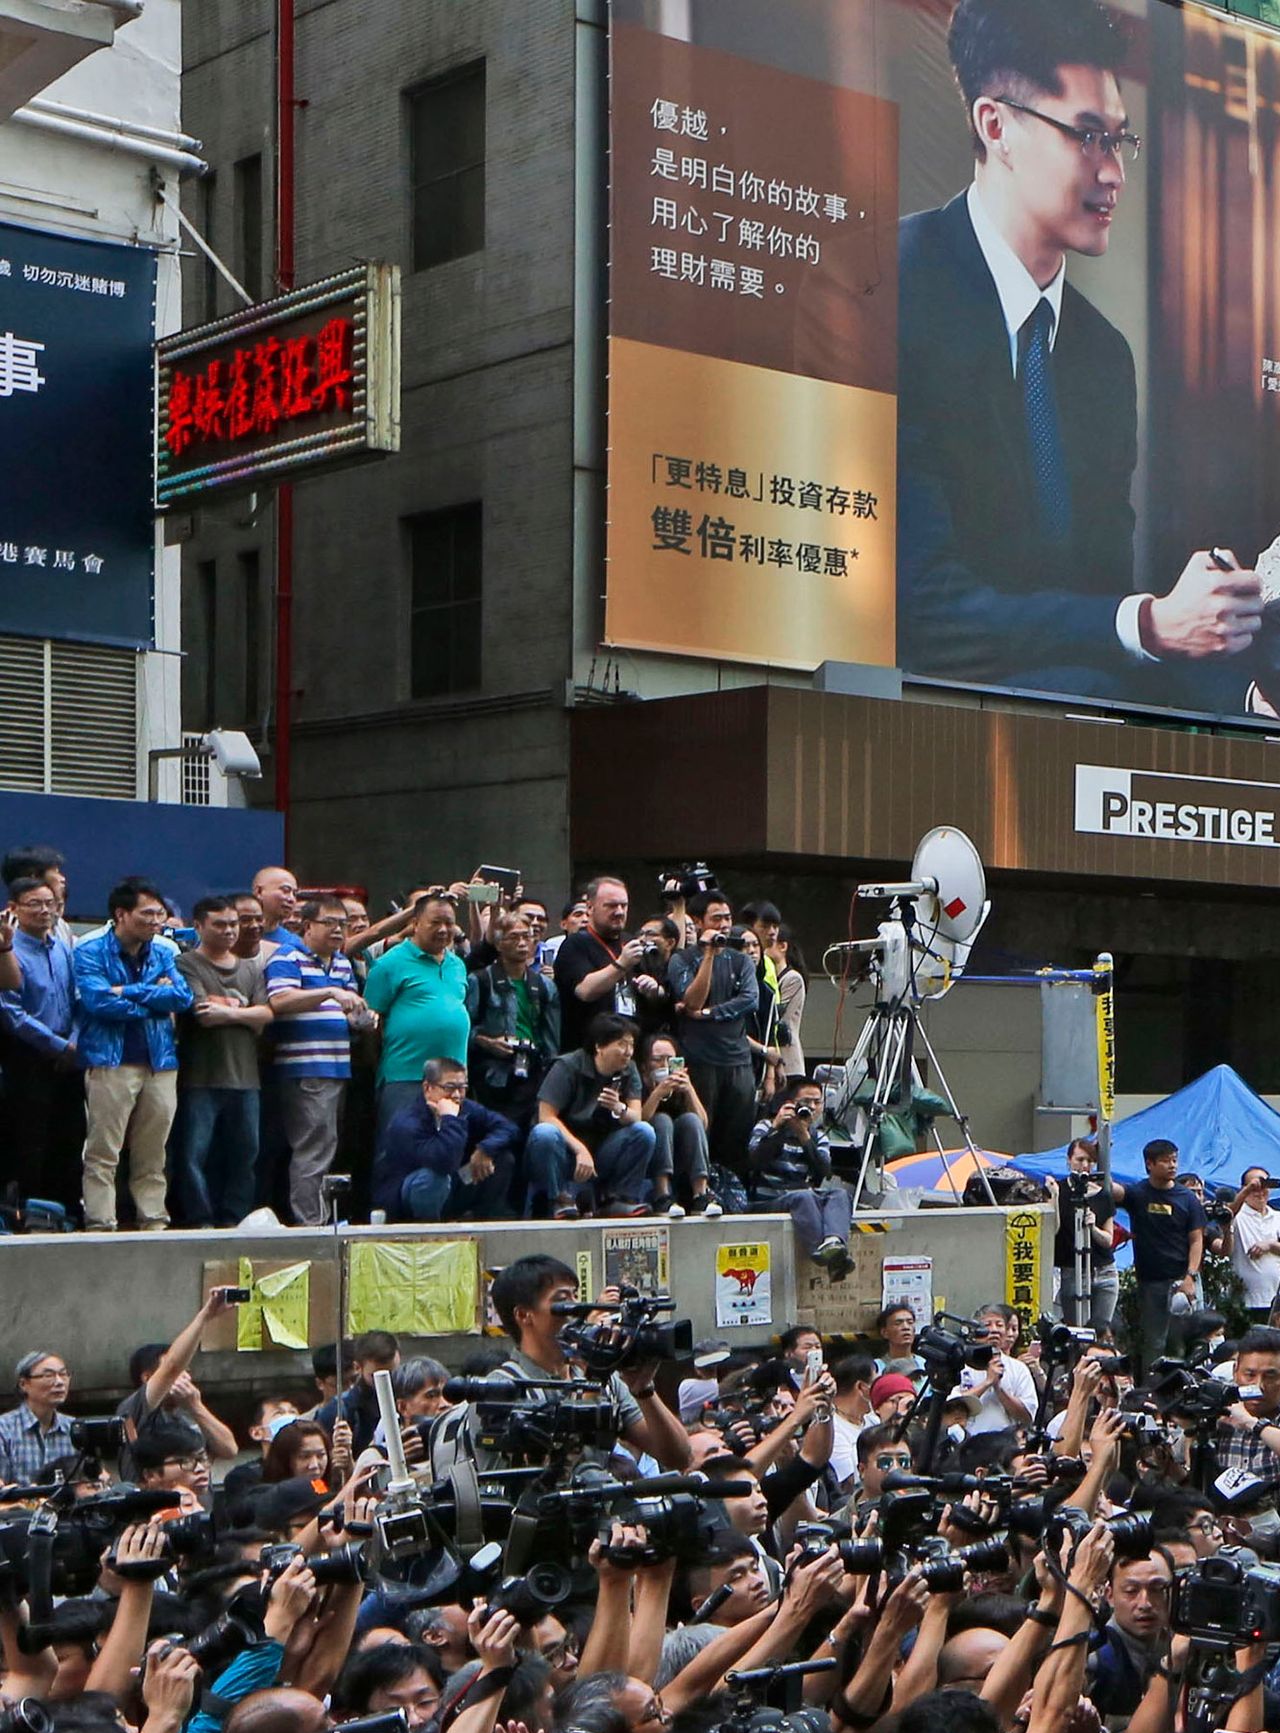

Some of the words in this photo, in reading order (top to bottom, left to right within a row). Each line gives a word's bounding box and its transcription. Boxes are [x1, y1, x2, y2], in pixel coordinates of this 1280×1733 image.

[650, 147, 866, 223] 是明白你的故事，
[650, 196, 820, 265] 用心了解你的
[22, 263, 127, 298] 切勿沉迷賭博
[650, 246, 786, 299] 理財需要。
[652, 453, 879, 521] 「更特息」投資存款
[1101, 790, 1276, 843] PRESTIGE
